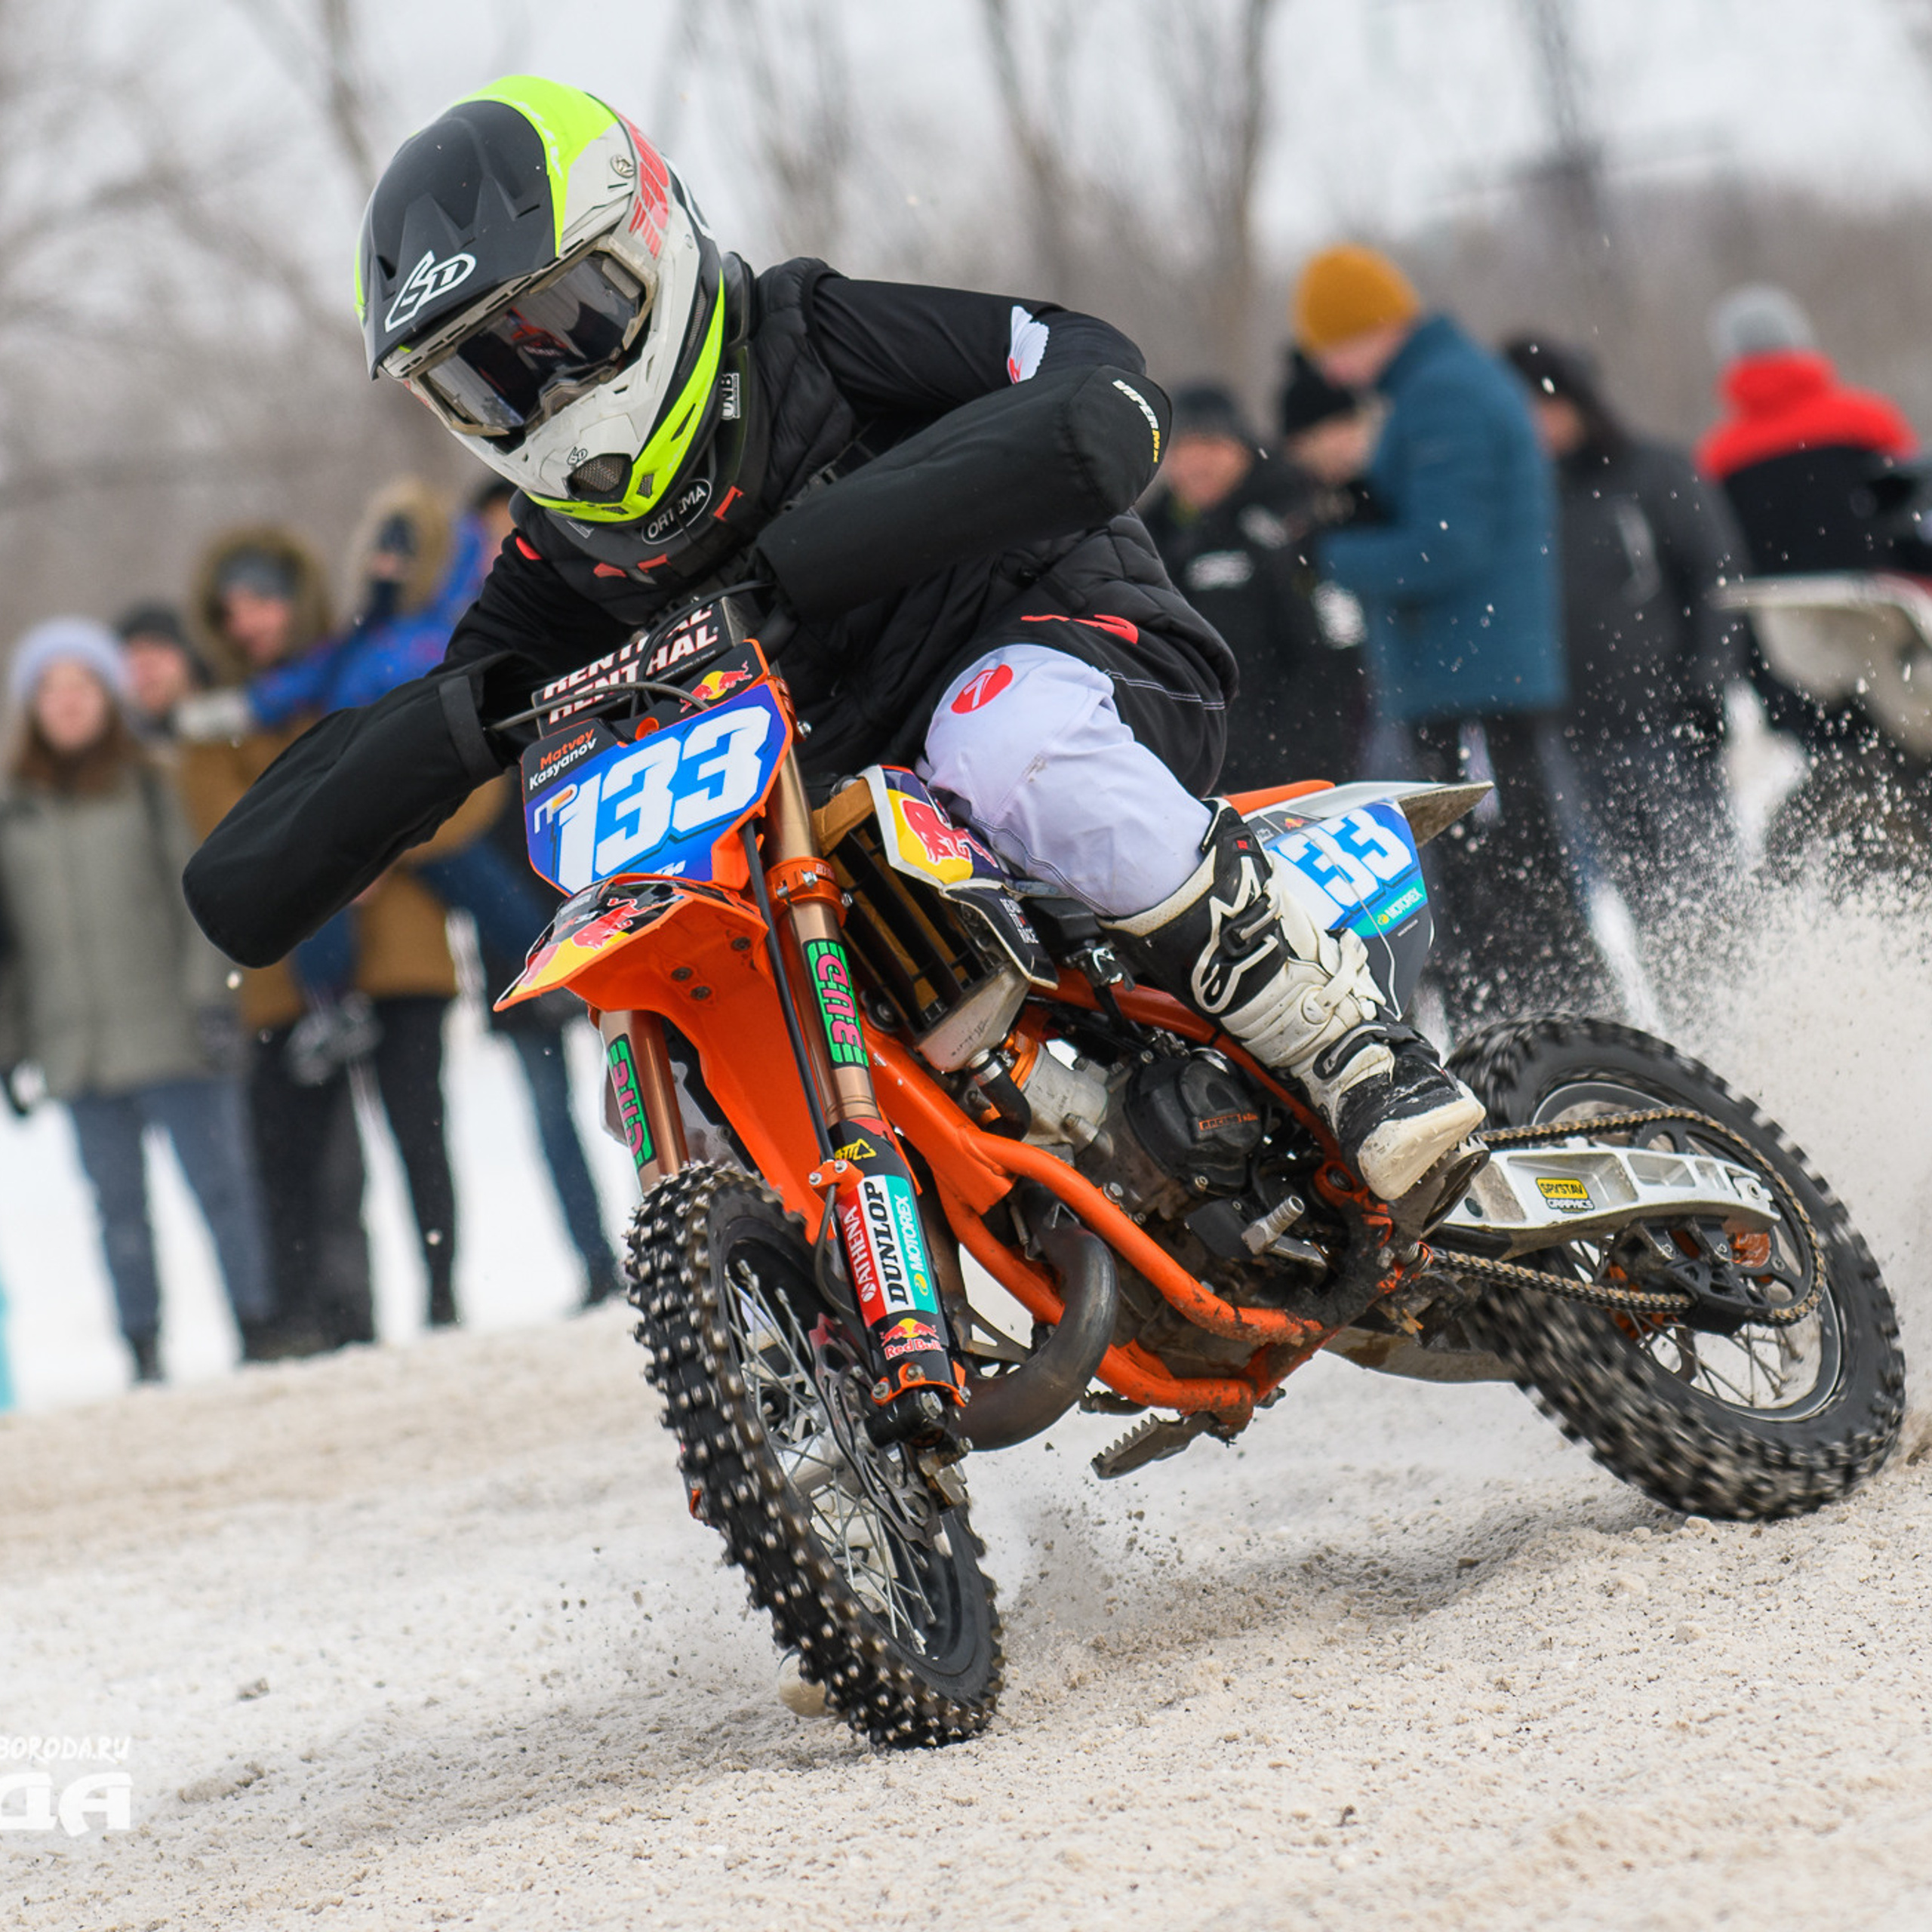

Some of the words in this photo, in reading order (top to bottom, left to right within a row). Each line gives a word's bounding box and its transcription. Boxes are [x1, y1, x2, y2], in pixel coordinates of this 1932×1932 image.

[549, 625, 718, 725] RENTHAL
[529, 738, 597, 791] Kasyanov
[540, 728, 595, 770] Matvey
[558, 705, 771, 895] 133
[1383, 887, 1424, 920] MOTOREX
[844, 1205, 873, 1286] ATHENA
[864, 1181, 909, 1305] DUNLOP
[894, 1194, 924, 1272] MOTOREX
[884, 1340, 913, 1360] Red
[915, 1338, 943, 1352] Bull
